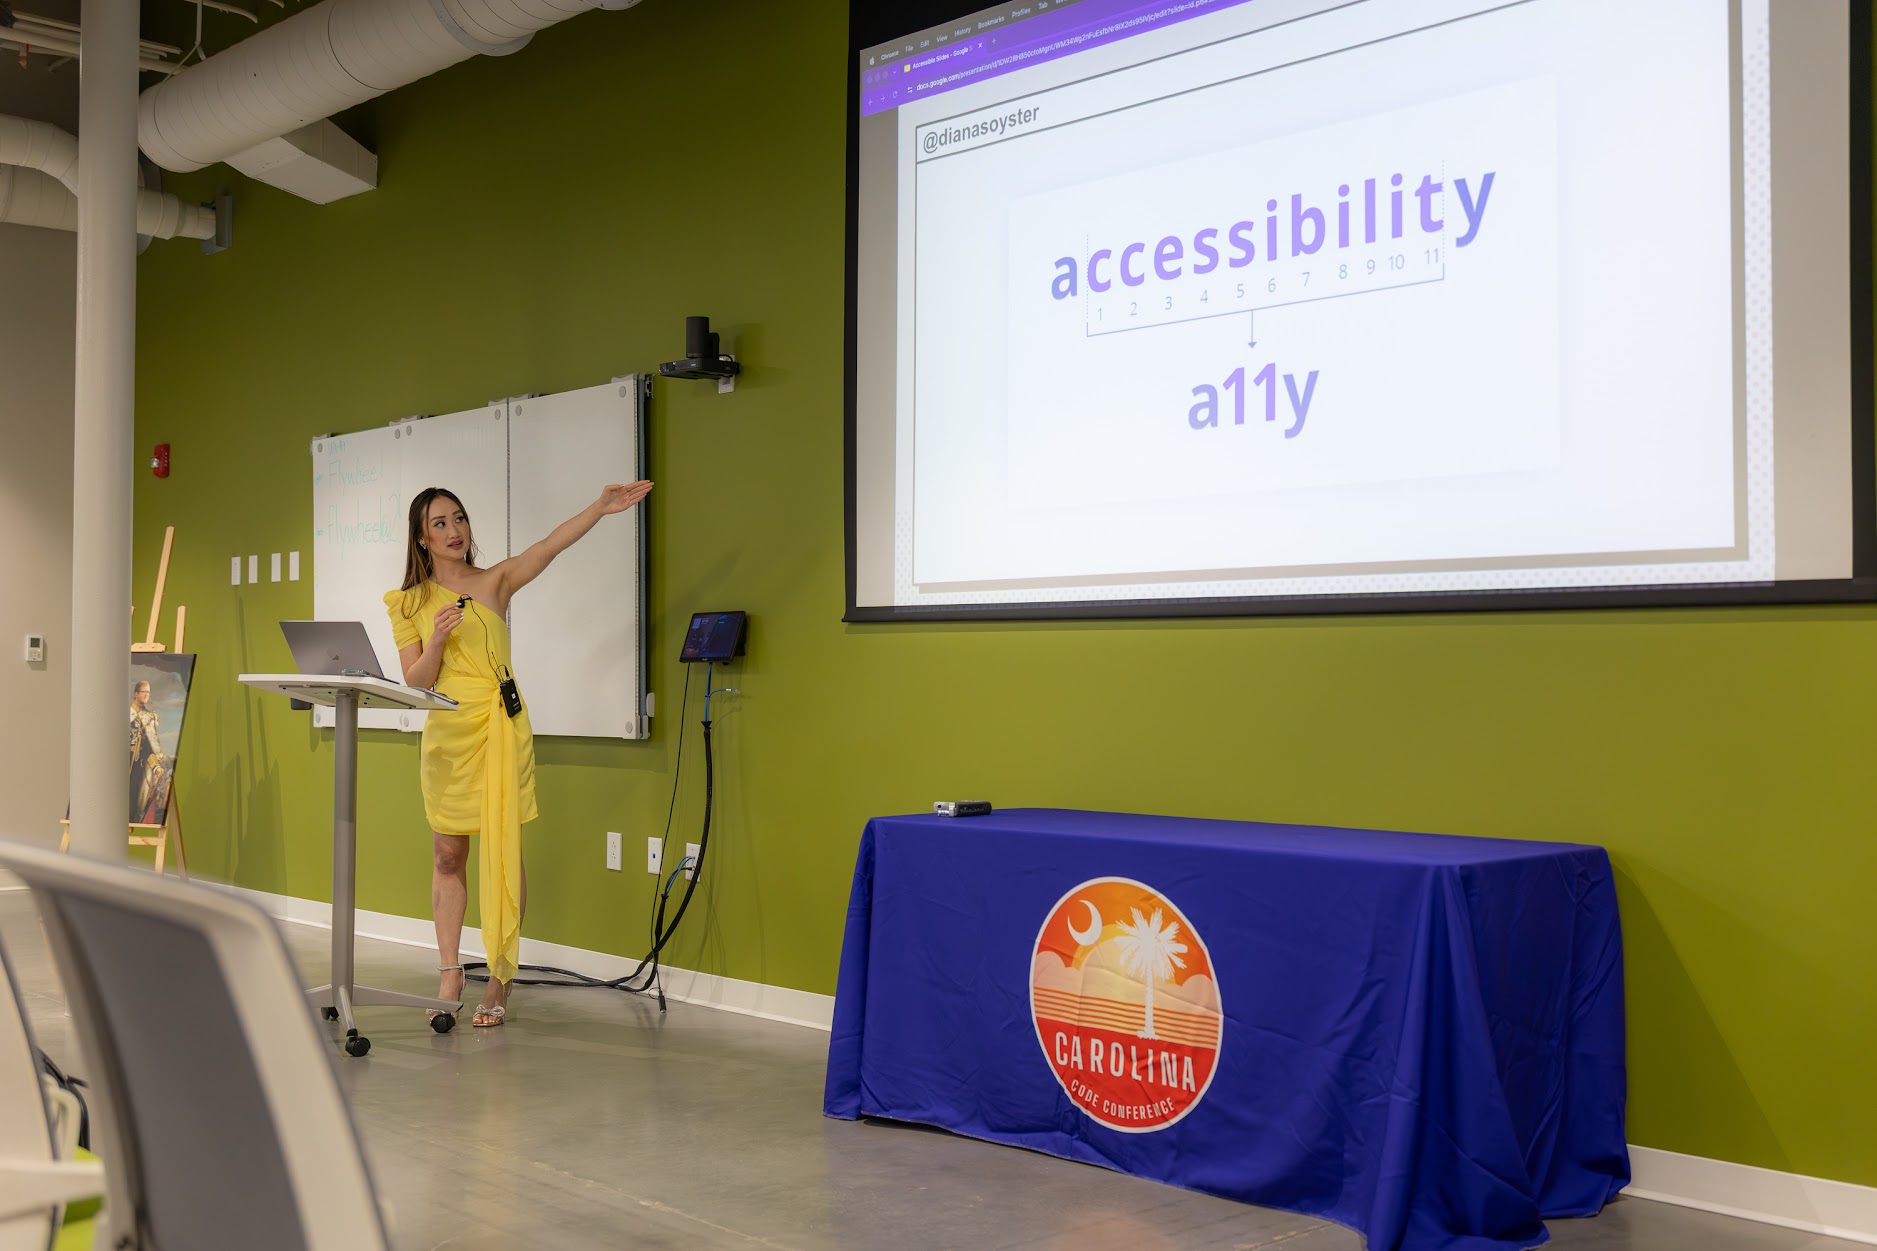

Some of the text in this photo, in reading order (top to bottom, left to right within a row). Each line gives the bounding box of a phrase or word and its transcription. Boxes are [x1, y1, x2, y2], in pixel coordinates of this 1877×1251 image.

[881, 2, 1048, 61] Chrome File Edit View History Bookmarks Profiles Tab
[912, 57, 935, 70] Accessible
[935, 53, 950, 64] Slides
[953, 46, 969, 59] Google
[923, 107, 1040, 154] @dianasoyster
[1051, 171, 1497, 300] accessibility
[1097, 248, 1440, 321] 1 2 3 4 5 6 7 8 9 10 11
[1188, 362, 1320, 439] a11y
[1054, 1031, 1197, 1093] CAROLINA
[1070, 1078, 1175, 1120] CODE CONFERENCE
